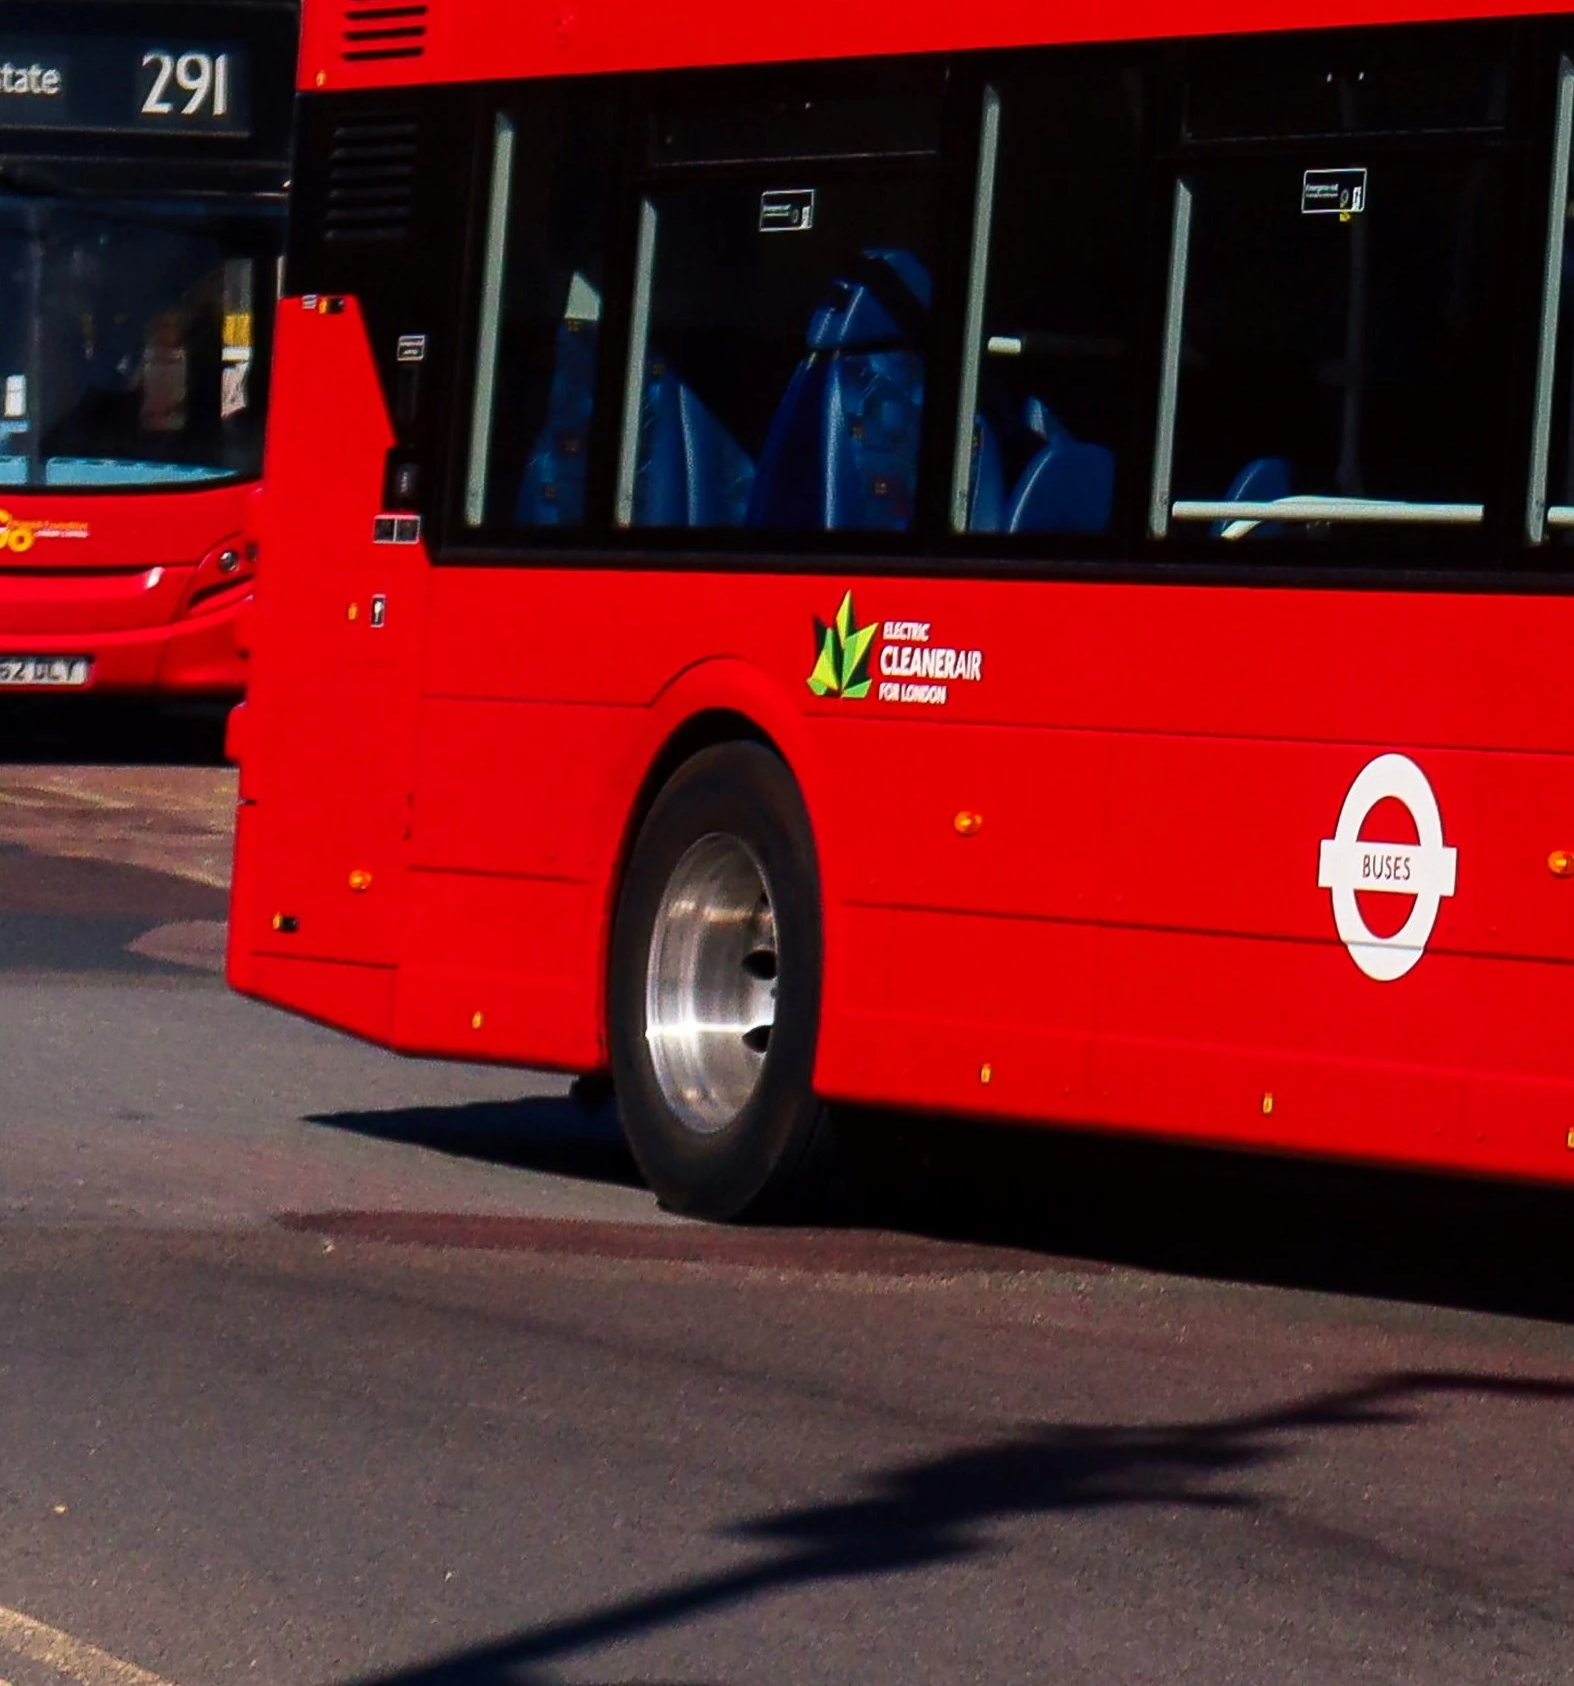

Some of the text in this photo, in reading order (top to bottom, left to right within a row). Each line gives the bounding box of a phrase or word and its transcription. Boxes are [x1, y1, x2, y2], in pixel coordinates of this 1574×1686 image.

[0, 61, 62, 95] tate
[140, 49, 228, 116] 291
[901, 683, 948, 705] LONDON
[1362, 854, 1412, 881] BUSES
